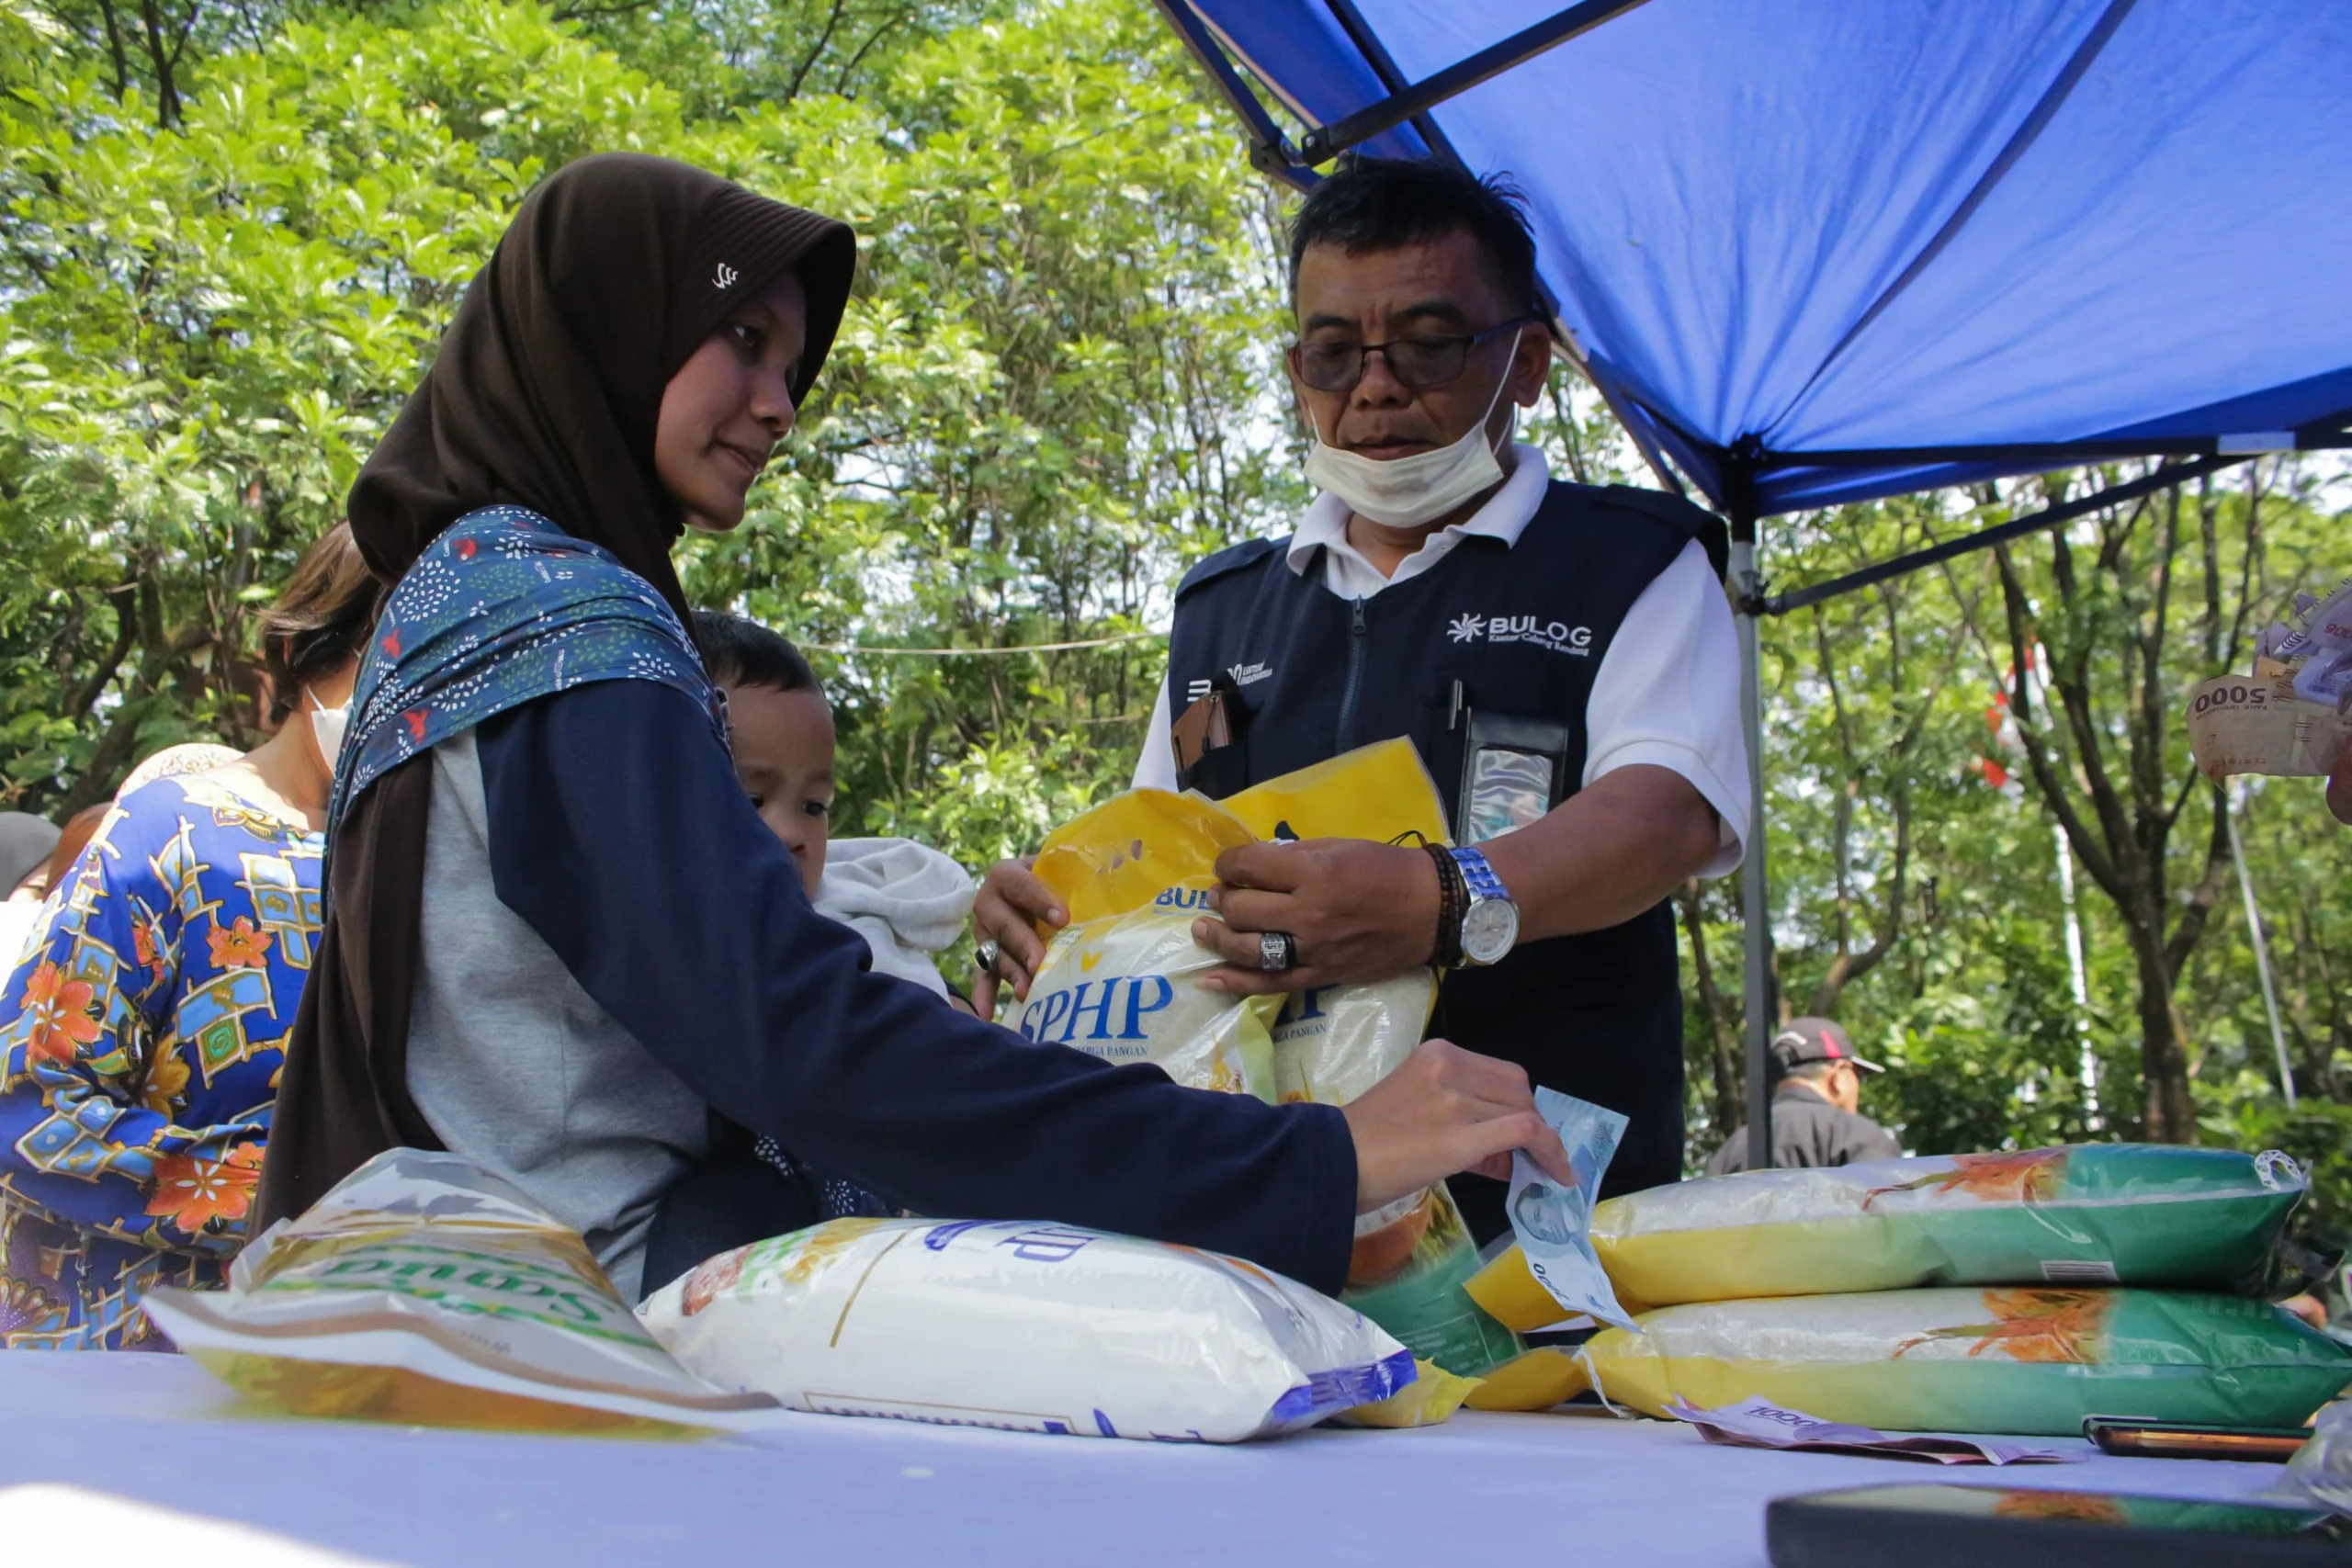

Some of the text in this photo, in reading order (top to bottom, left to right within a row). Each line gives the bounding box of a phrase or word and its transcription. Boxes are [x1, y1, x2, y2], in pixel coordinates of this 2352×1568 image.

[1488, 615, 1592, 647] BULOG
[2194, 685, 2267, 714] 5000
[1155, 886, 1214, 911] BUL
[1020, 974, 1174, 1044] SPHP
[1106, 1045, 1148, 1057] PANGAN
